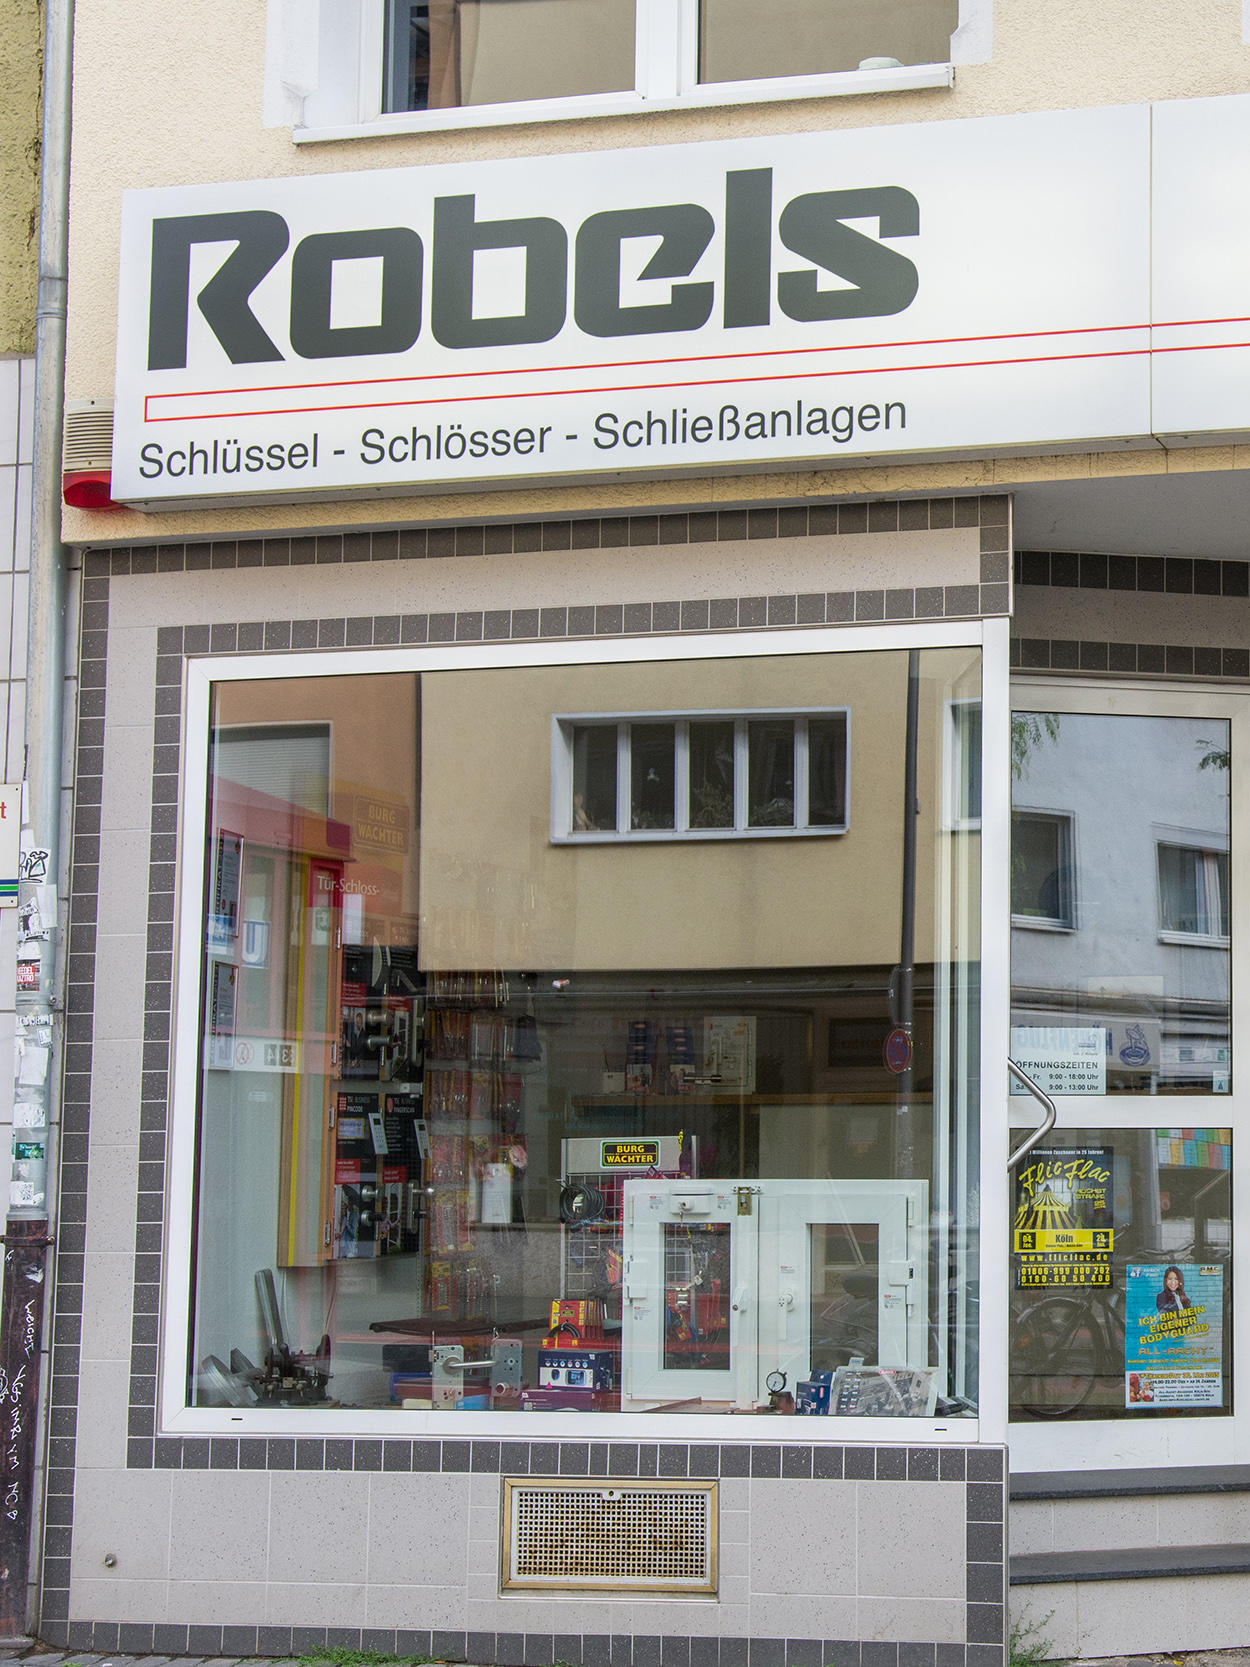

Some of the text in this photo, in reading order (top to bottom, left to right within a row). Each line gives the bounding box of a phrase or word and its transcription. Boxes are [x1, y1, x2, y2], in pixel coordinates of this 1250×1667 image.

[147, 167, 921, 371] Robels
[139, 432, 319, 481] Schlüssel
[358, 423, 552, 467] Schlösser
[592, 398, 908, 452] Schließanlagen
[368, 804, 397, 824] BURG
[317, 875, 380, 896] Tür-Schloss-
[616, 1145, 645, 1153] BURG
[1019, 1159, 1111, 1198] Flic Flac
[1055, 1234, 1074, 1243] Köln
[1021, 1253, 1108, 1262] www.flicflac.de
[1091, 1274, 1110, 1282] 400
[1094, 1266, 1110, 1274] 202
[1138, 1305, 1206, 1327] ICH BIN MEIN
[1149, 1316, 1197, 1334] EIGENER
[1139, 1323, 1209, 1345] BODYGUARD
